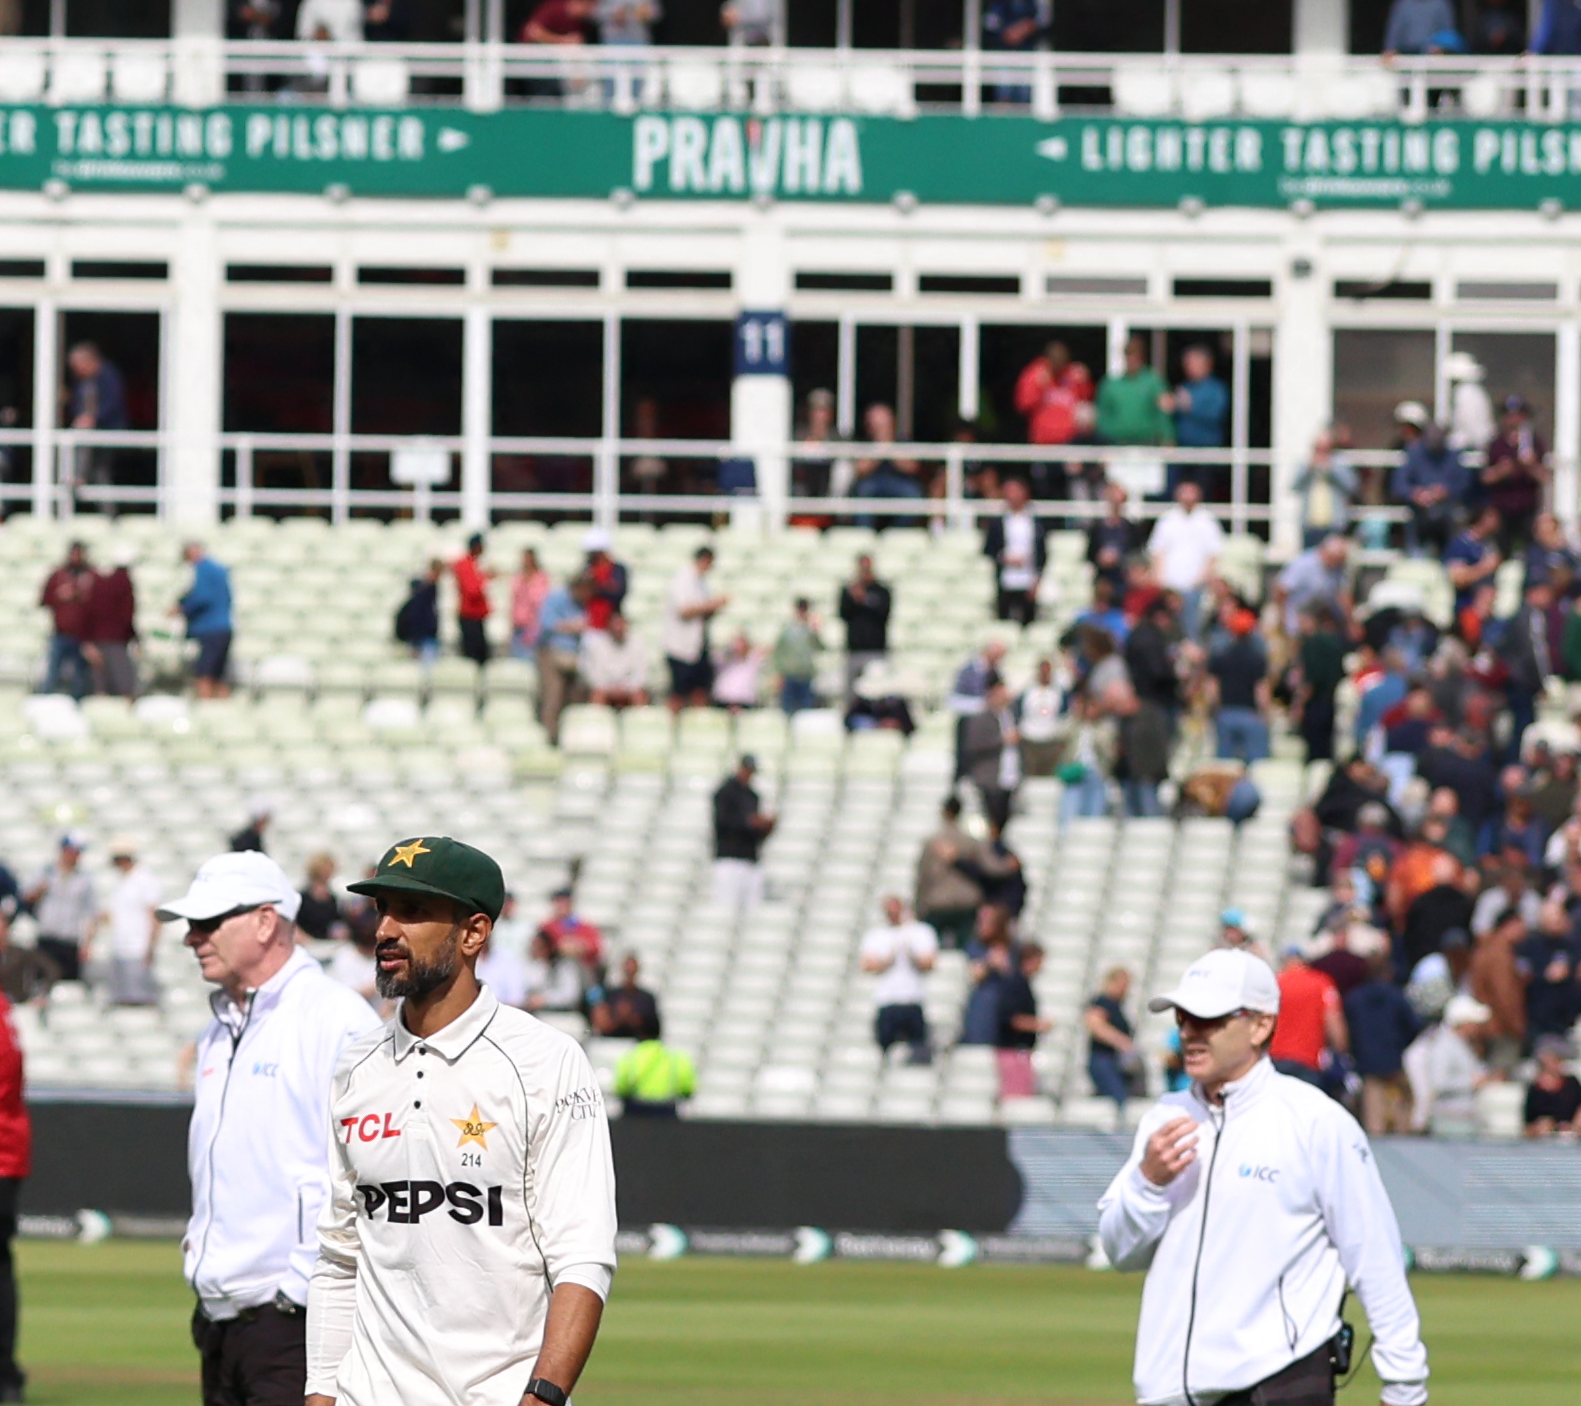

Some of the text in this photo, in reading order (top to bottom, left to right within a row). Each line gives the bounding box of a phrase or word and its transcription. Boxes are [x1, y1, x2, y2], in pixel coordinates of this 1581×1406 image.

[56, 111, 229, 158] TASTING
[247, 114, 424, 162] PILSNER
[633, 115, 861, 194] PRAVHA
[1082, 126, 1261, 172] LIGHTER
[1280, 128, 1459, 175] TASTING
[741, 321, 785, 366] 11
[340, 1112, 402, 1144] TCL
[460, 1152, 483, 1168] 214
[1253, 1165, 1281, 1184] ICC
[356, 1179, 504, 1228] PEPSI
